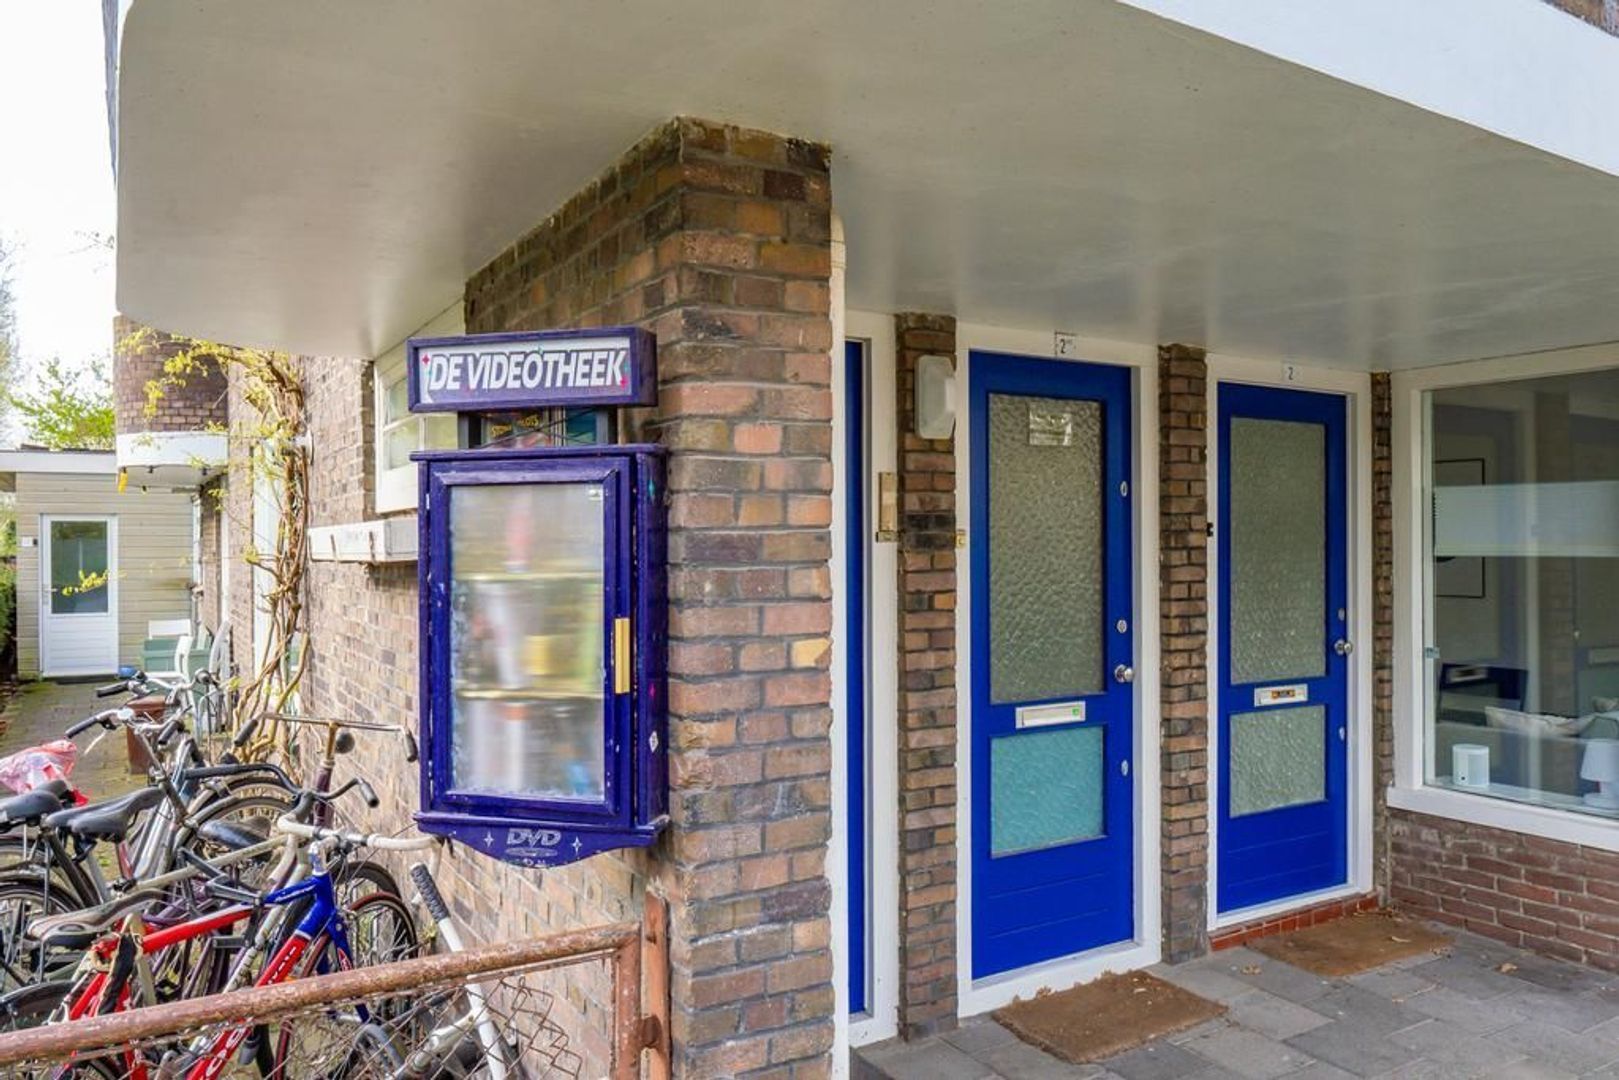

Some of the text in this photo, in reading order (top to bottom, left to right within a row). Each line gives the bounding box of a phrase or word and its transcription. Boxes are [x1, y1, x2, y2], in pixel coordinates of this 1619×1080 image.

[429, 350, 627, 391] DE VIDEOTHEEK
[506, 828, 562, 848] DVD
